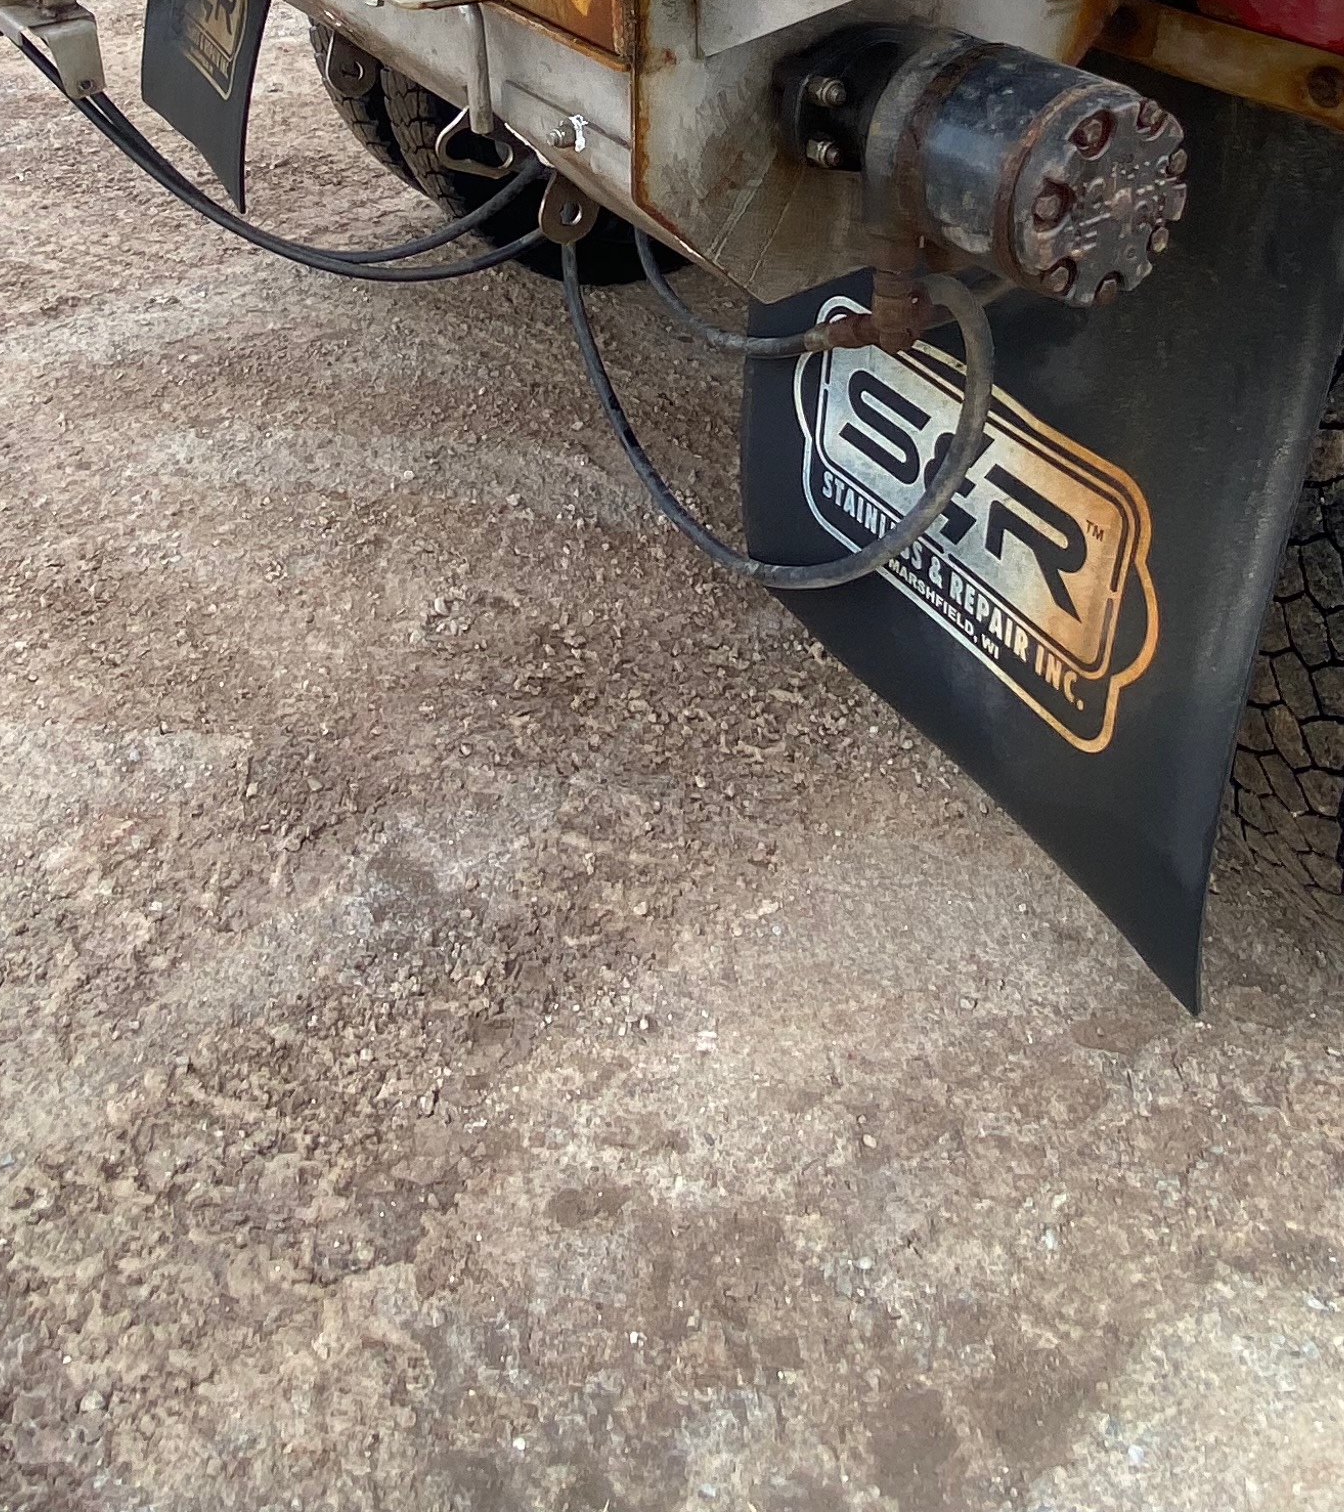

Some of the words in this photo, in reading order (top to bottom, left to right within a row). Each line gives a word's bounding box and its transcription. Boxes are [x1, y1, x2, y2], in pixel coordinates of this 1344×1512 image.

[822, 470, 923, 570] STAINLS
[928, 556, 943, 589] &
[950, 570, 1030, 663] REPAIR
[1034, 645, 1084, 711] INC.
[888, 558, 979, 644] MARSHFIELD,
[981, 633, 1000, 660] WI
